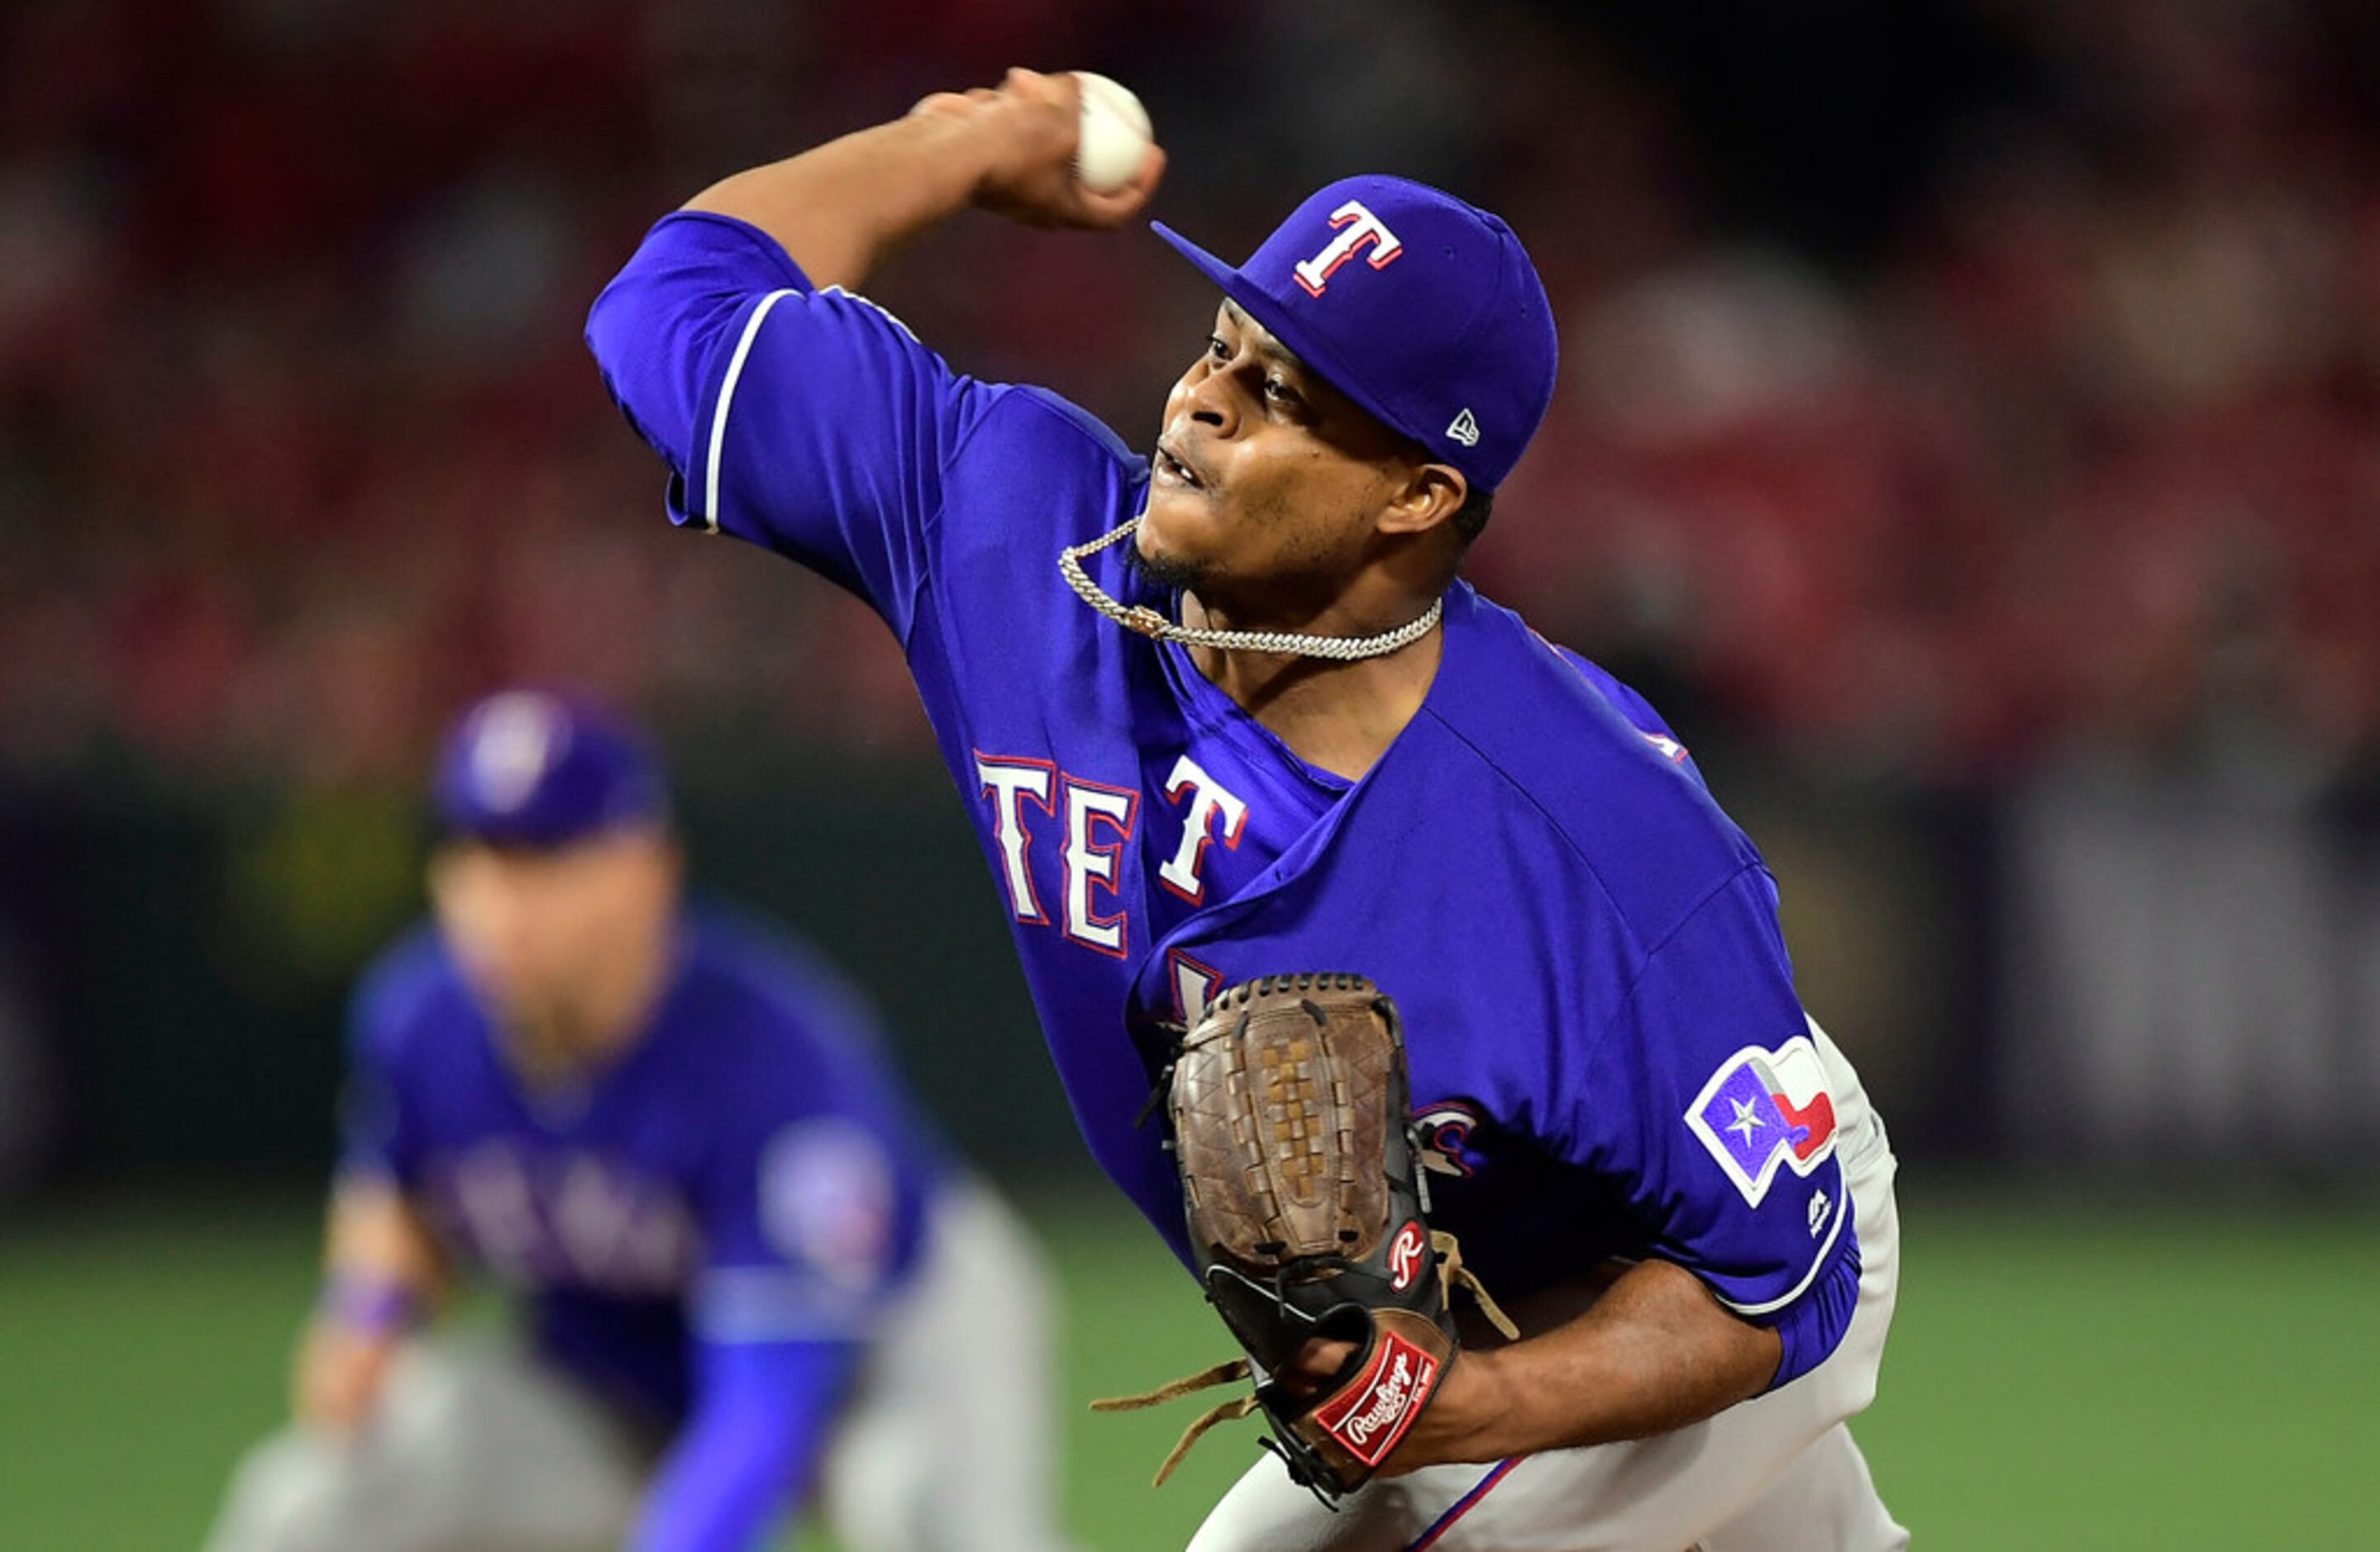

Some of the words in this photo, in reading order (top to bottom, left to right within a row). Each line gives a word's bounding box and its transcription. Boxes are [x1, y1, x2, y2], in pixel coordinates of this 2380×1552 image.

[1293, 199, 1404, 298] T
[1159, 754, 1249, 907] T
[1346, 1352, 1412, 1445] Rawlings
